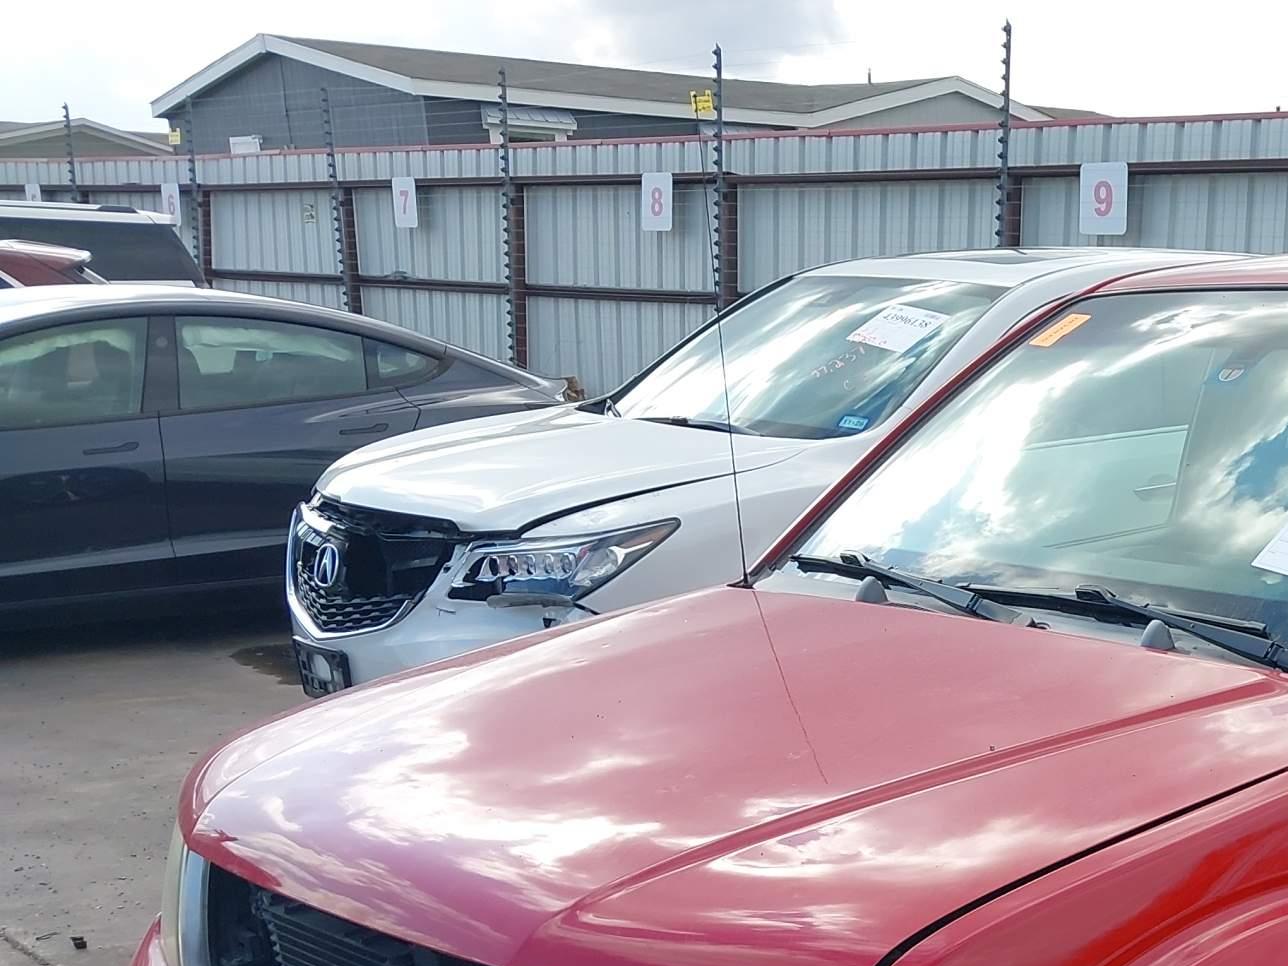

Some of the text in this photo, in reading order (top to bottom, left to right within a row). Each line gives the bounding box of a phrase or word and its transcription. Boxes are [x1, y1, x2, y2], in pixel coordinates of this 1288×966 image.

[167, 193, 176, 216] 6
[399, 190, 410, 215] 7
[650, 187, 664, 217] 8
[1094, 180, 1113, 217] 9
